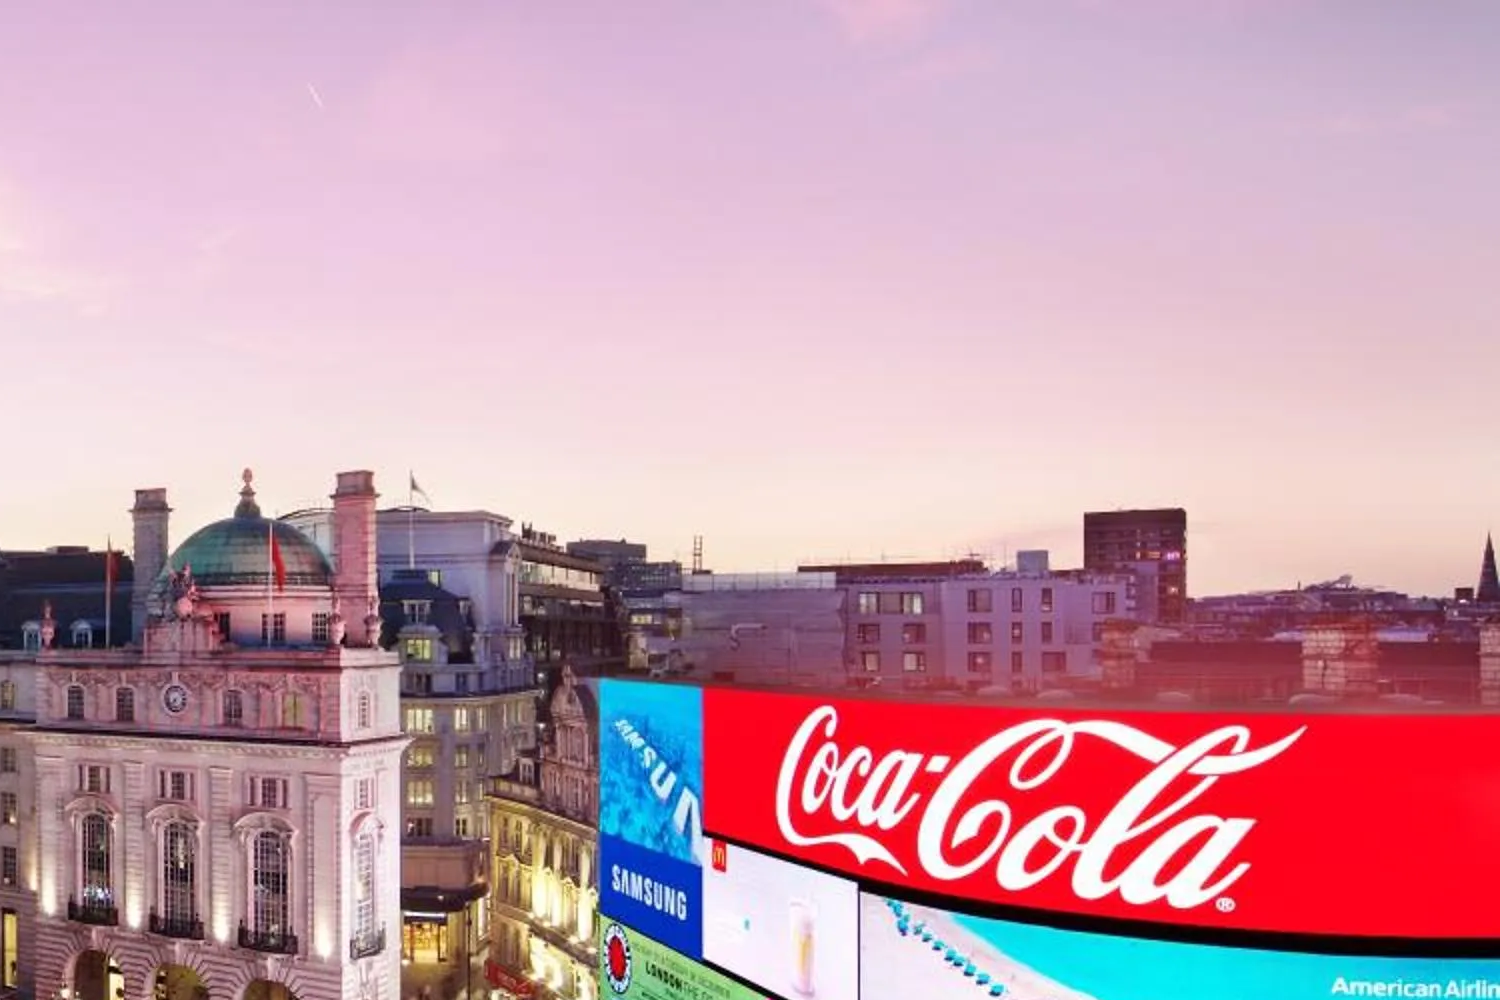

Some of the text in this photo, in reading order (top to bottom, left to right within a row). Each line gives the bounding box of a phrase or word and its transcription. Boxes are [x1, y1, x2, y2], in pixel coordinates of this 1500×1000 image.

[776, 706, 1307, 909] Coca-Cola
[611, 864, 687, 921] SAMSUNG
[1332, 976, 1442, 998] American
